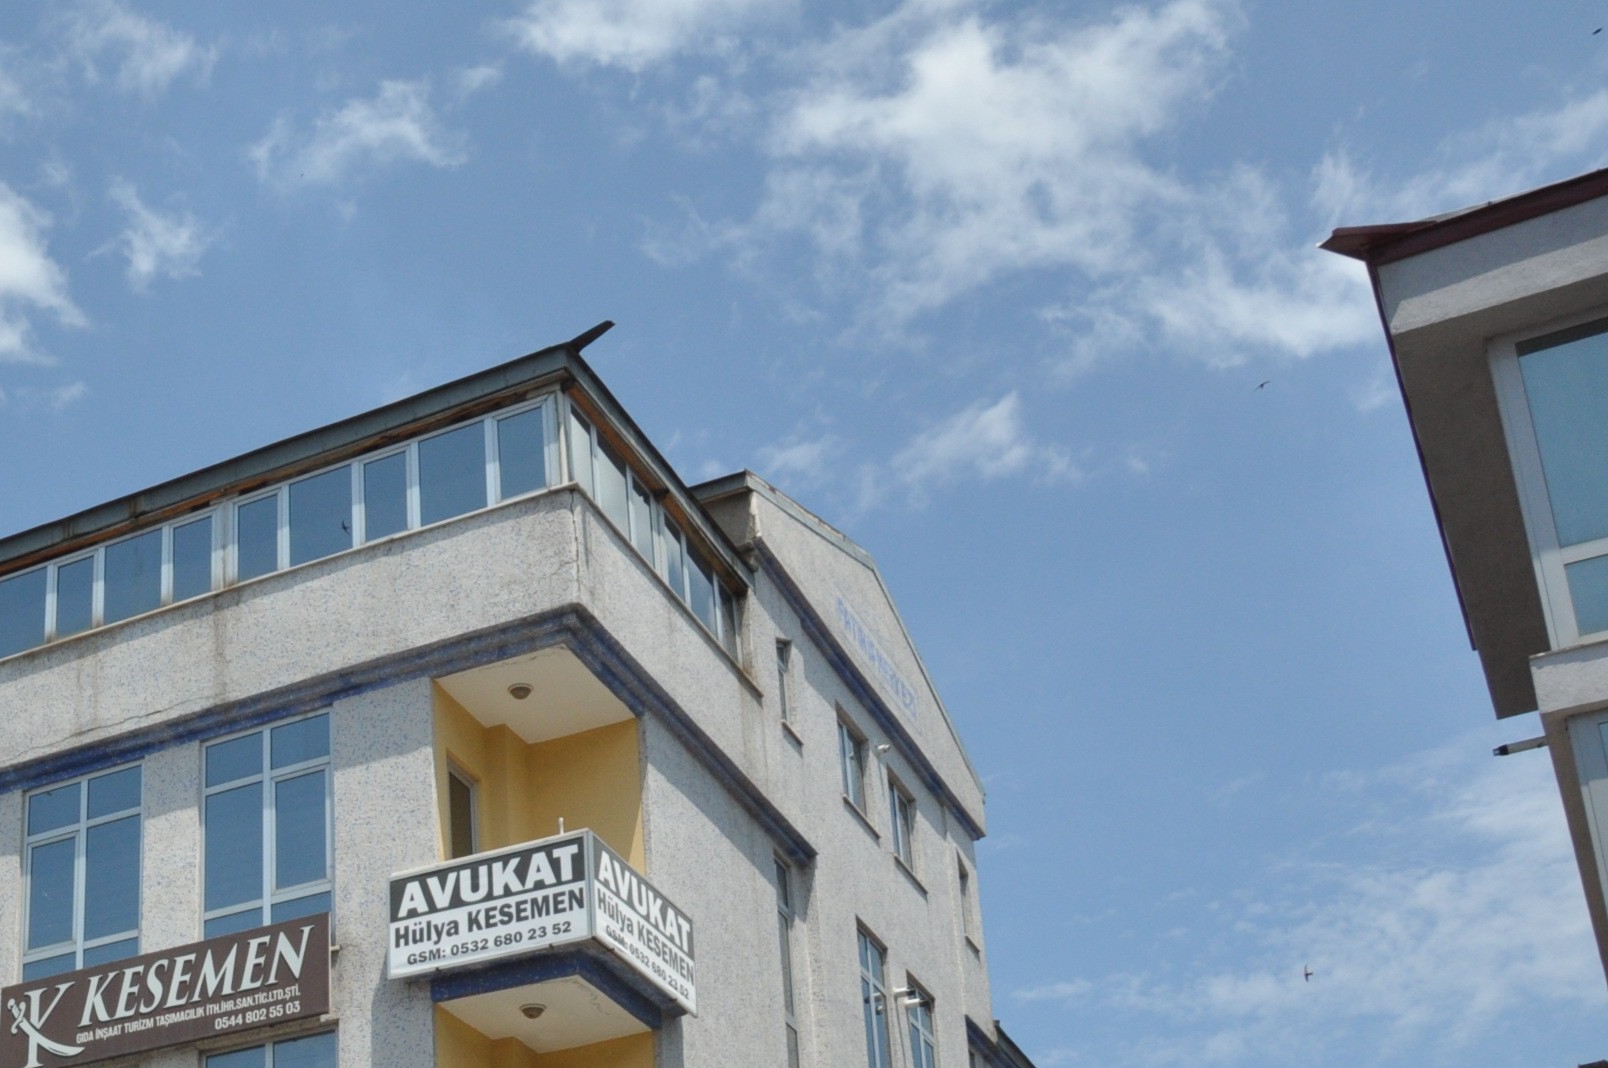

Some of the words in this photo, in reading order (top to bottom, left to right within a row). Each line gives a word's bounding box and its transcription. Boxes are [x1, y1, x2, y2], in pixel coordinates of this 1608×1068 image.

[397, 844, 579, 919] AVUKAT
[598, 850, 691, 954] AVUKAT
[395, 919, 459, 949] Hülya
[467, 887, 585, 932] KESEMEN
[407, 947, 447, 966] GSM:
[450, 938, 489, 956] 0532
[493, 930, 523, 948] 680
[527, 925, 548, 941] 23
[552, 920, 572, 935] 52
[597, 888, 634, 936] Hülya
[637, 920, 694, 986] KESEMEN
[78, 925, 315, 1029] KESEMEN
[629, 944, 651, 968] 0532
[651, 961, 667, 981] 680
[668, 974, 678, 991] 23
[679, 984, 690, 1000] 52
[76, 1030, 94, 1044] GIDA
[95, 1024, 122, 1041] İNŞAAT
[124, 1018, 154, 1034] TURİZM
[156, 1006, 204, 1028] TAŞIMACILIK
[215, 1013, 243, 1030] 0544
[245, 1008, 267, 1024] 802
[269, 1004, 284, 1019] 55
[285, 1000, 301, 1015] 03
